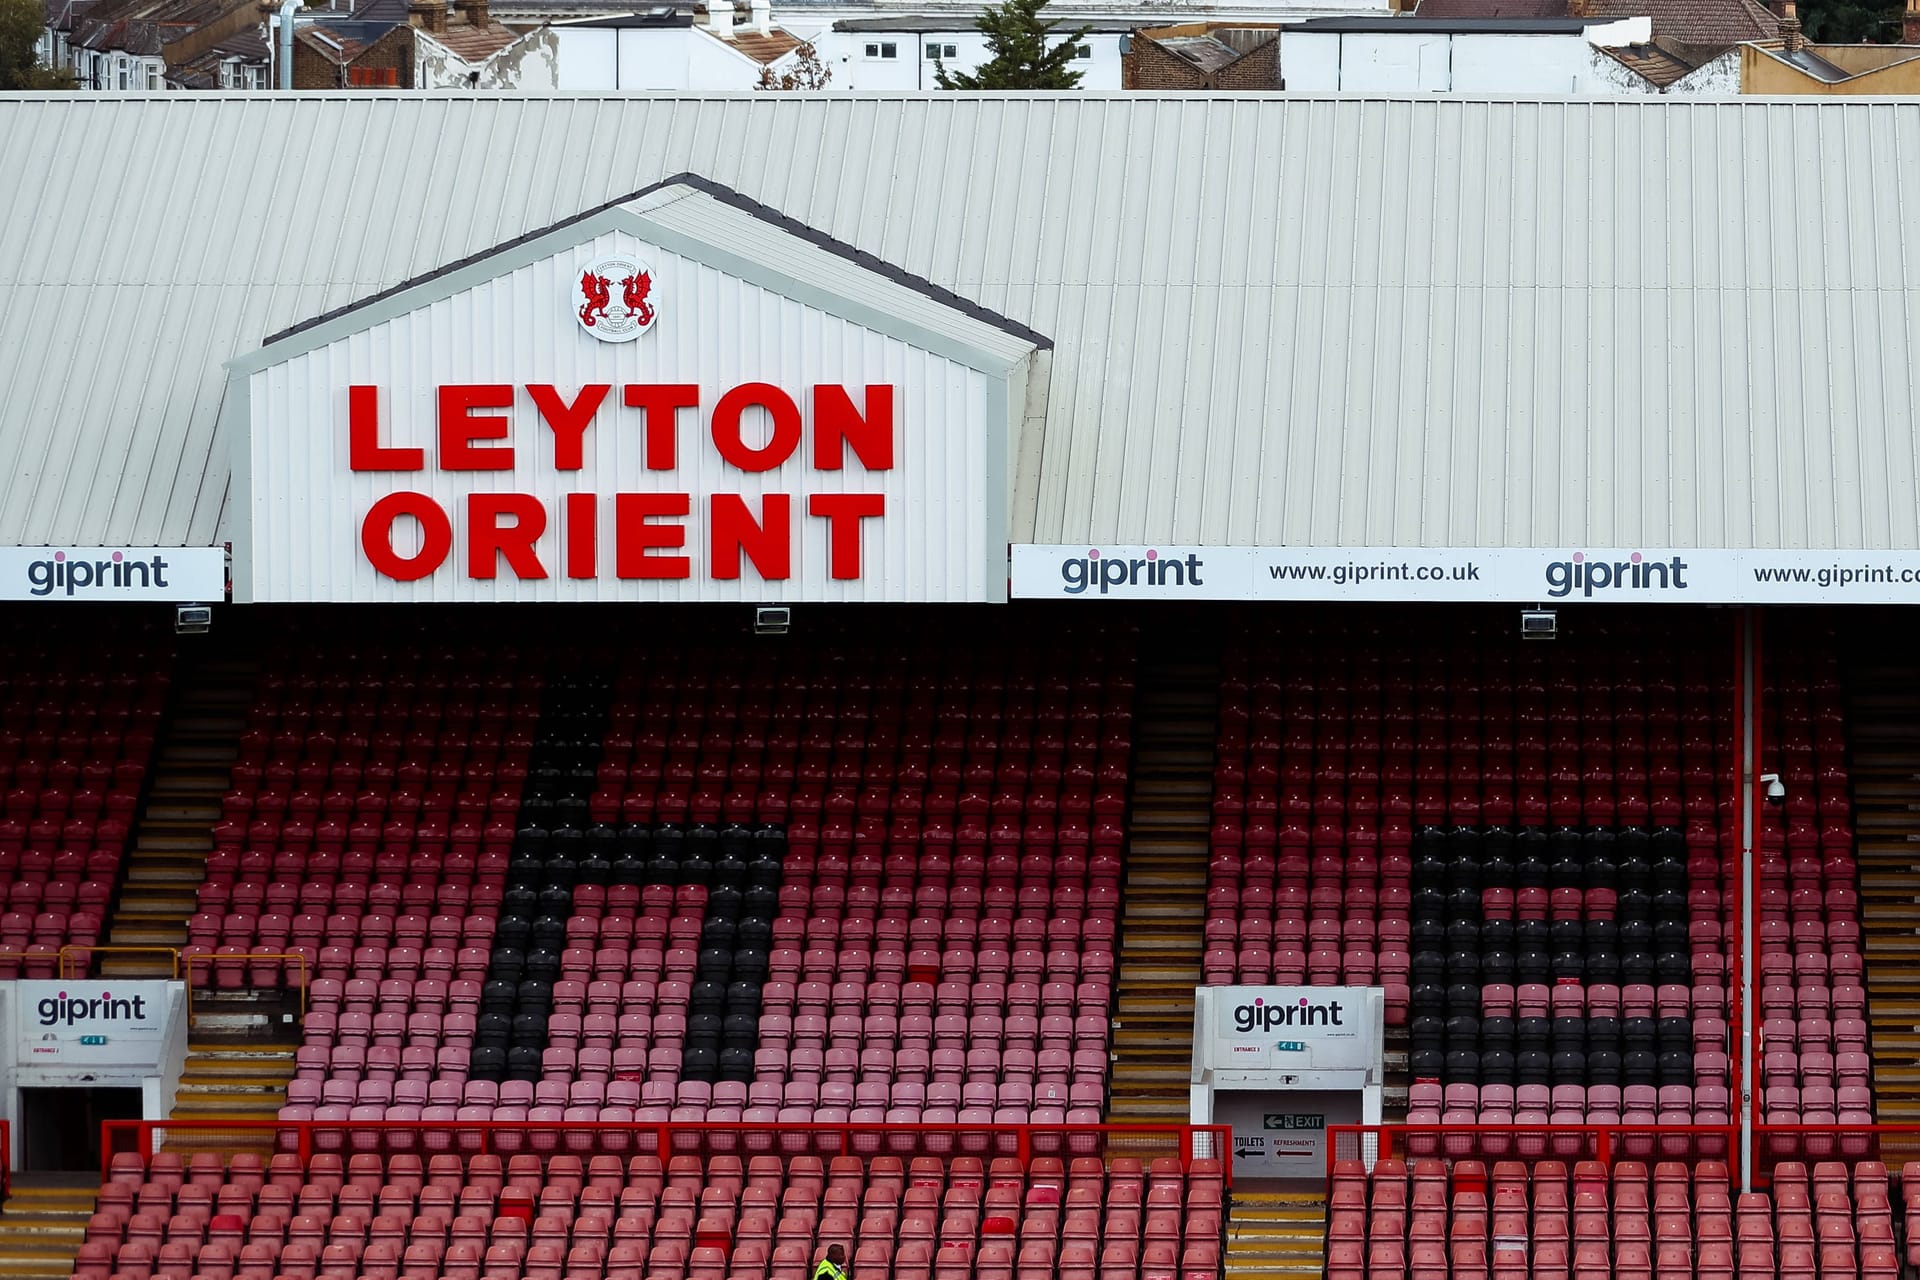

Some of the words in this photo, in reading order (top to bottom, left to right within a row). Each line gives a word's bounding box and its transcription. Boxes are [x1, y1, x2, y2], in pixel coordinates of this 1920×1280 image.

[350, 383, 893, 472] LEYTON
[362, 491, 884, 580] ORIENT
[28, 551, 168, 597] giprint
[1061, 548, 1204, 593] giprint
[1270, 562, 1480, 585] www.giprint.co.uk
[1546, 551, 1688, 597] giprint
[38, 991, 146, 1026] giprint
[1234, 997, 1343, 1033] giprint
[1296, 1116, 1323, 1128] EXIT
[1234, 1137, 1265, 1147] TOILETS
[1273, 1139, 1316, 1147] REFRESHMENTS
